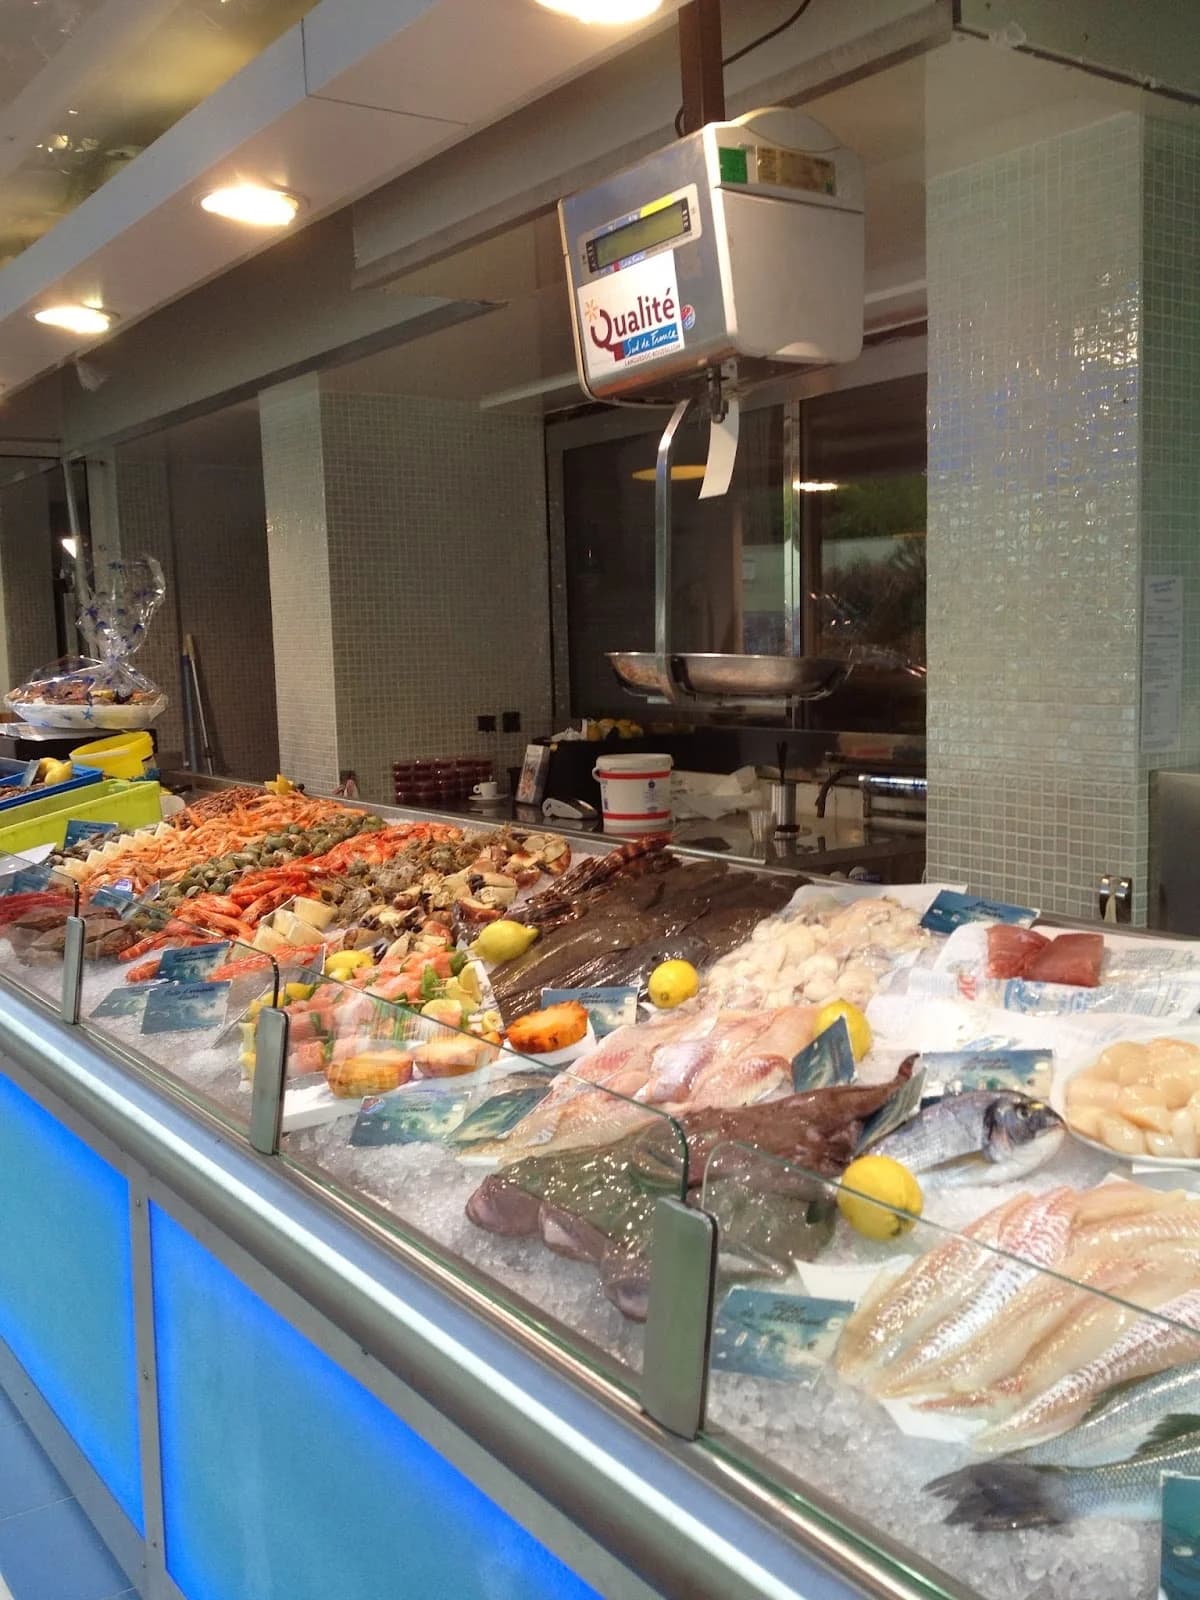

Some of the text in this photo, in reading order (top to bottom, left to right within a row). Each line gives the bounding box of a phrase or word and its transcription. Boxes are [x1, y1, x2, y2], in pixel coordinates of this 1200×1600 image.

[591, 287, 675, 351] Qualité
[626, 338, 640, 357] Sud
[641, 337, 651, 350] de
[651, 329, 677, 347] France
